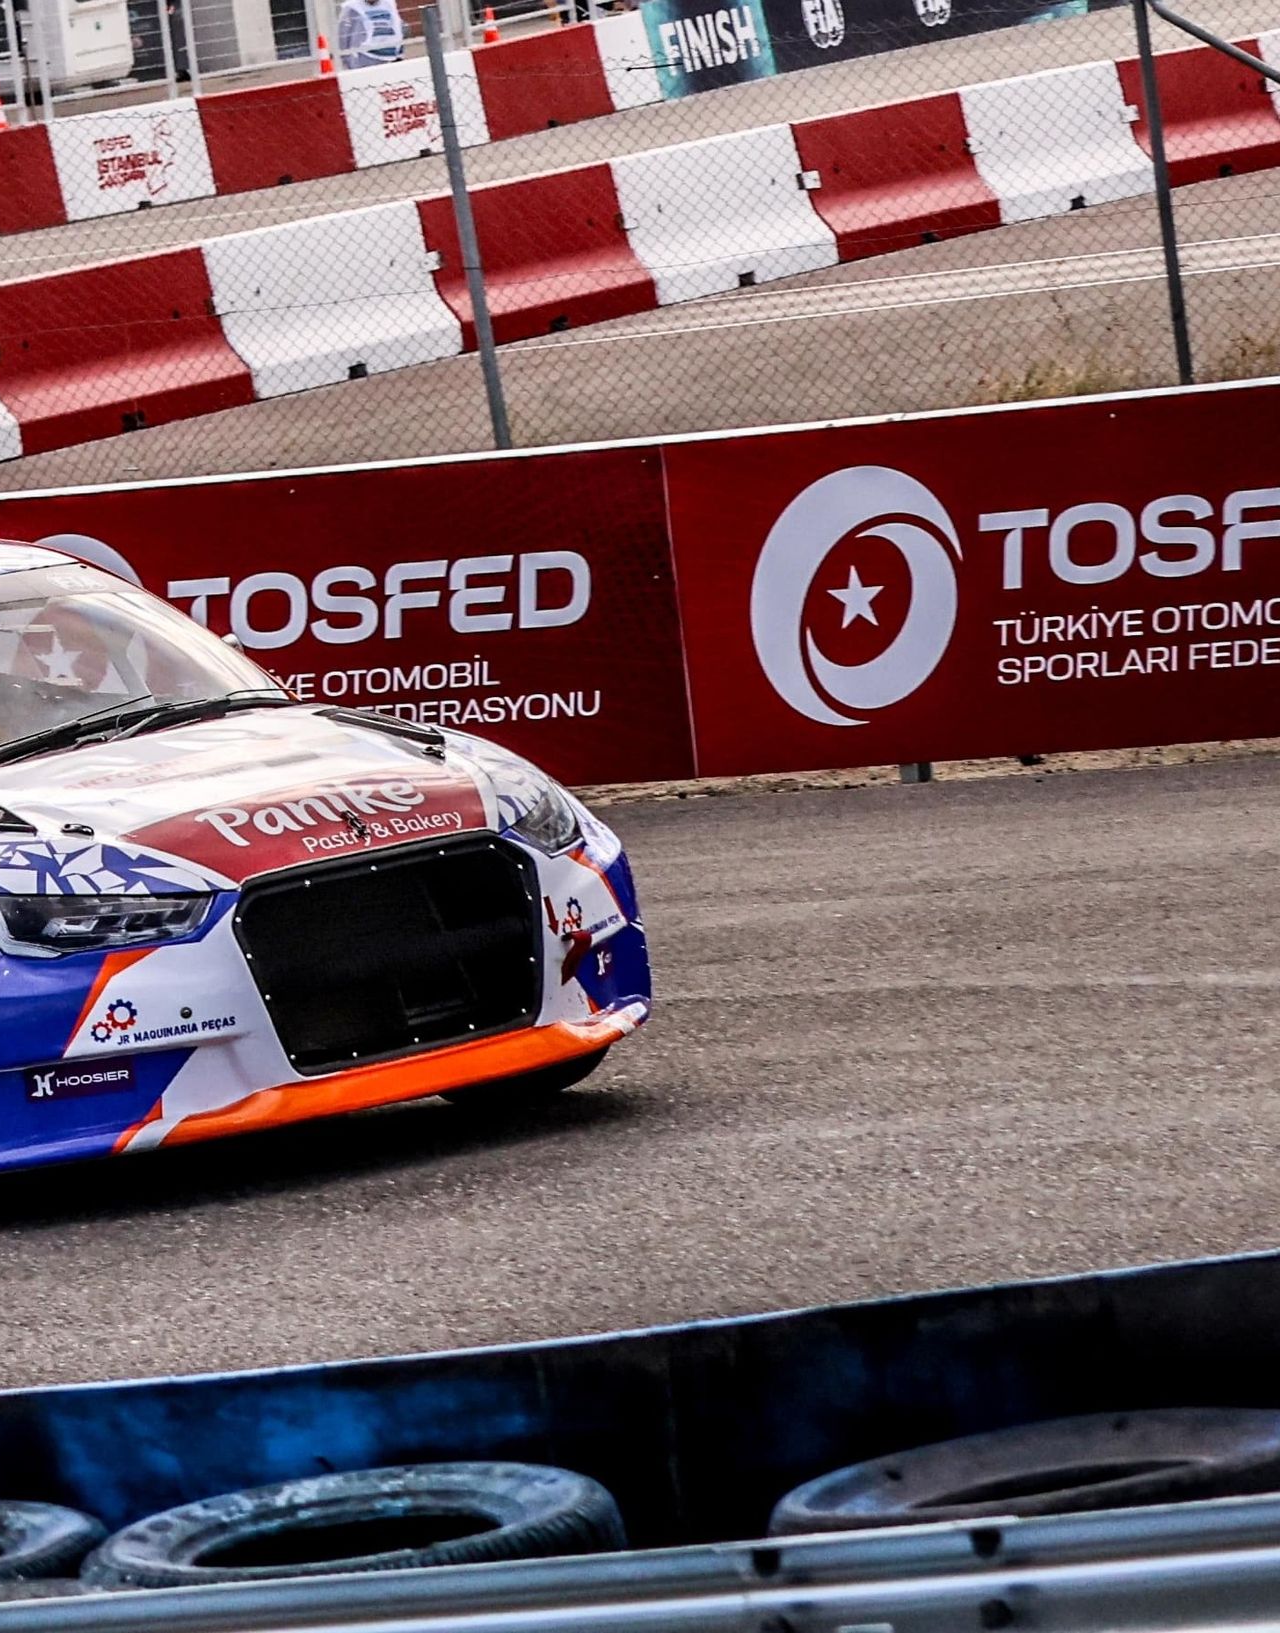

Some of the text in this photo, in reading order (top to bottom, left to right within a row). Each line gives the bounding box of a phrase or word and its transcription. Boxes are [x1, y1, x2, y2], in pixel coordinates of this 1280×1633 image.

[659, 6, 760, 76] FINISH
[383, 100, 439, 122] ISTANBU
[167, 550, 591, 650] TOSFED
[993, 605, 1144, 646] TÜRKİYE
[322, 654, 501, 698] OTOMOBİL
[997, 646, 1178, 685] SPORLARI
[356, 690, 601, 725] DERASYONU
[194, 780, 426, 847] Panike
[372, 822, 392, 838] &
[393, 809, 462, 837] Bakery
[117, 1016, 236, 1046] JR MAQUINARIA PEÇAS
[56, 1069, 130, 1088] HOOSIER
